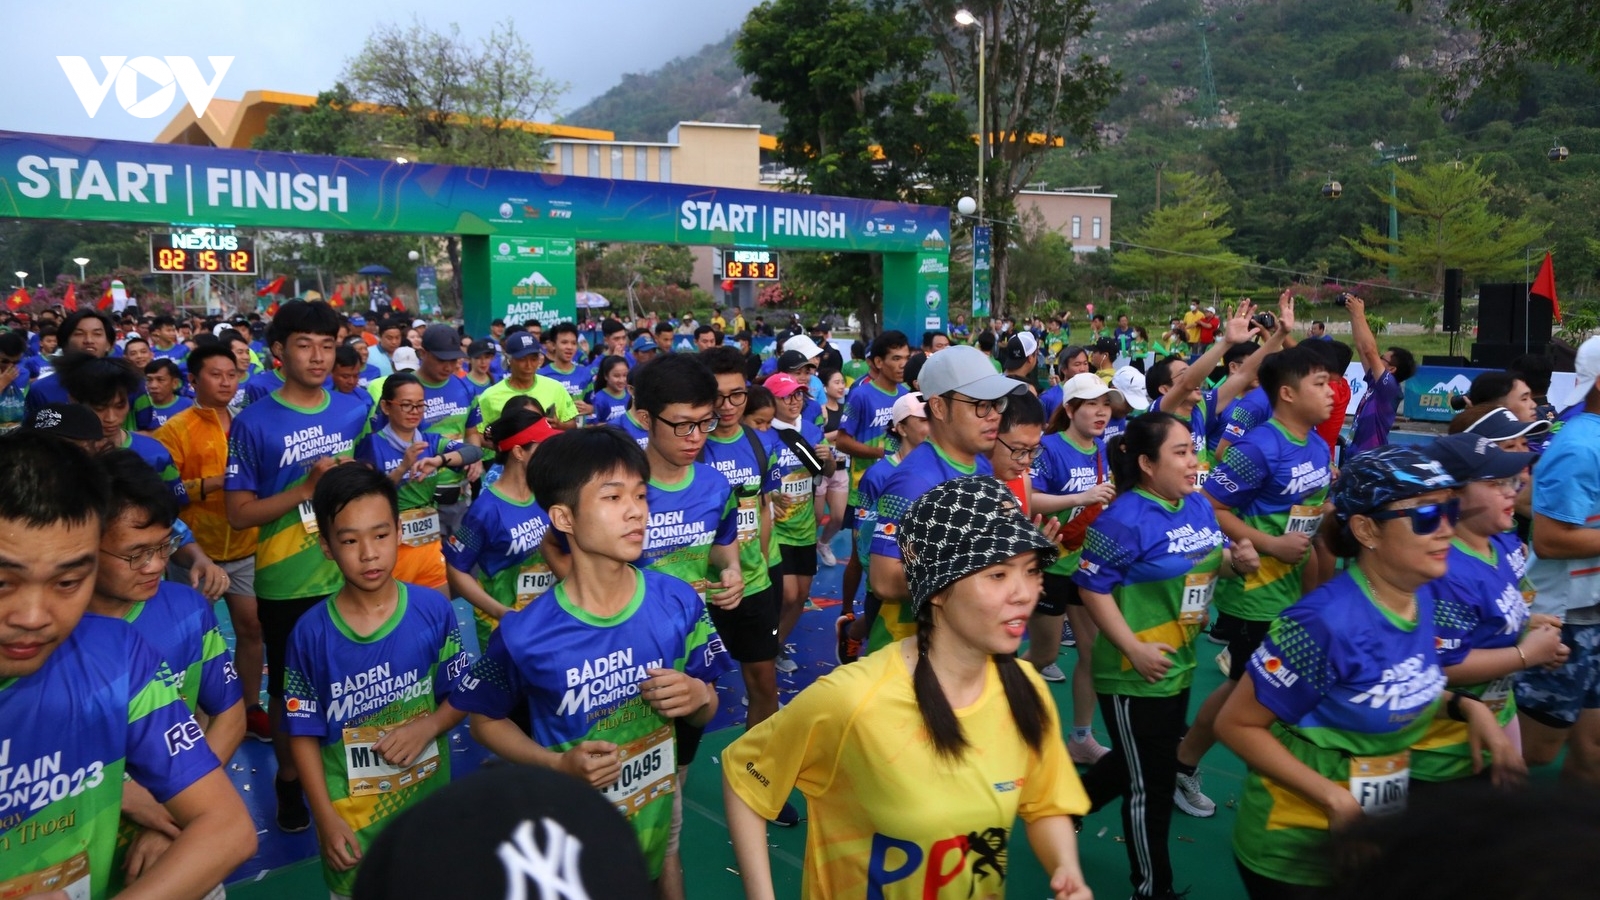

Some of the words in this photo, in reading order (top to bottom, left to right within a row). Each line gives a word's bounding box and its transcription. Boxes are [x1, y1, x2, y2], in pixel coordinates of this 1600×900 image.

[17, 155, 173, 204] START
[207, 167, 348, 213] FINISH
[681, 200, 757, 233] START
[773, 207, 846, 239] FINISH
[171, 233, 238, 250] NEXUS
[159, 249, 185, 270] 02
[735, 251, 770, 263] NEXUS
[728, 262, 742, 277] 02
[507, 301, 543, 314] BADEN
[426, 402, 457, 412] OUNTAIN
[875, 407, 893, 417] BADE
[284, 425, 323, 447] BADEN
[280, 432, 342, 468] MOUNTAIN
[1070, 466, 1095, 477] BADEN
[401, 518, 433, 534] F10293
[510, 515, 543, 539] BADEN
[647, 510, 684, 527] ADEN
[737, 511, 756, 526] 019
[643, 521, 705, 546] OUNTAIN
[523, 574, 551, 588] F103
[566, 647, 632, 688] BADEN
[331, 661, 390, 699] BADEN
[326, 668, 418, 722] MOUNTAIN
[351, 747, 389, 769] M1
[0, 751, 61, 792] TAIN
